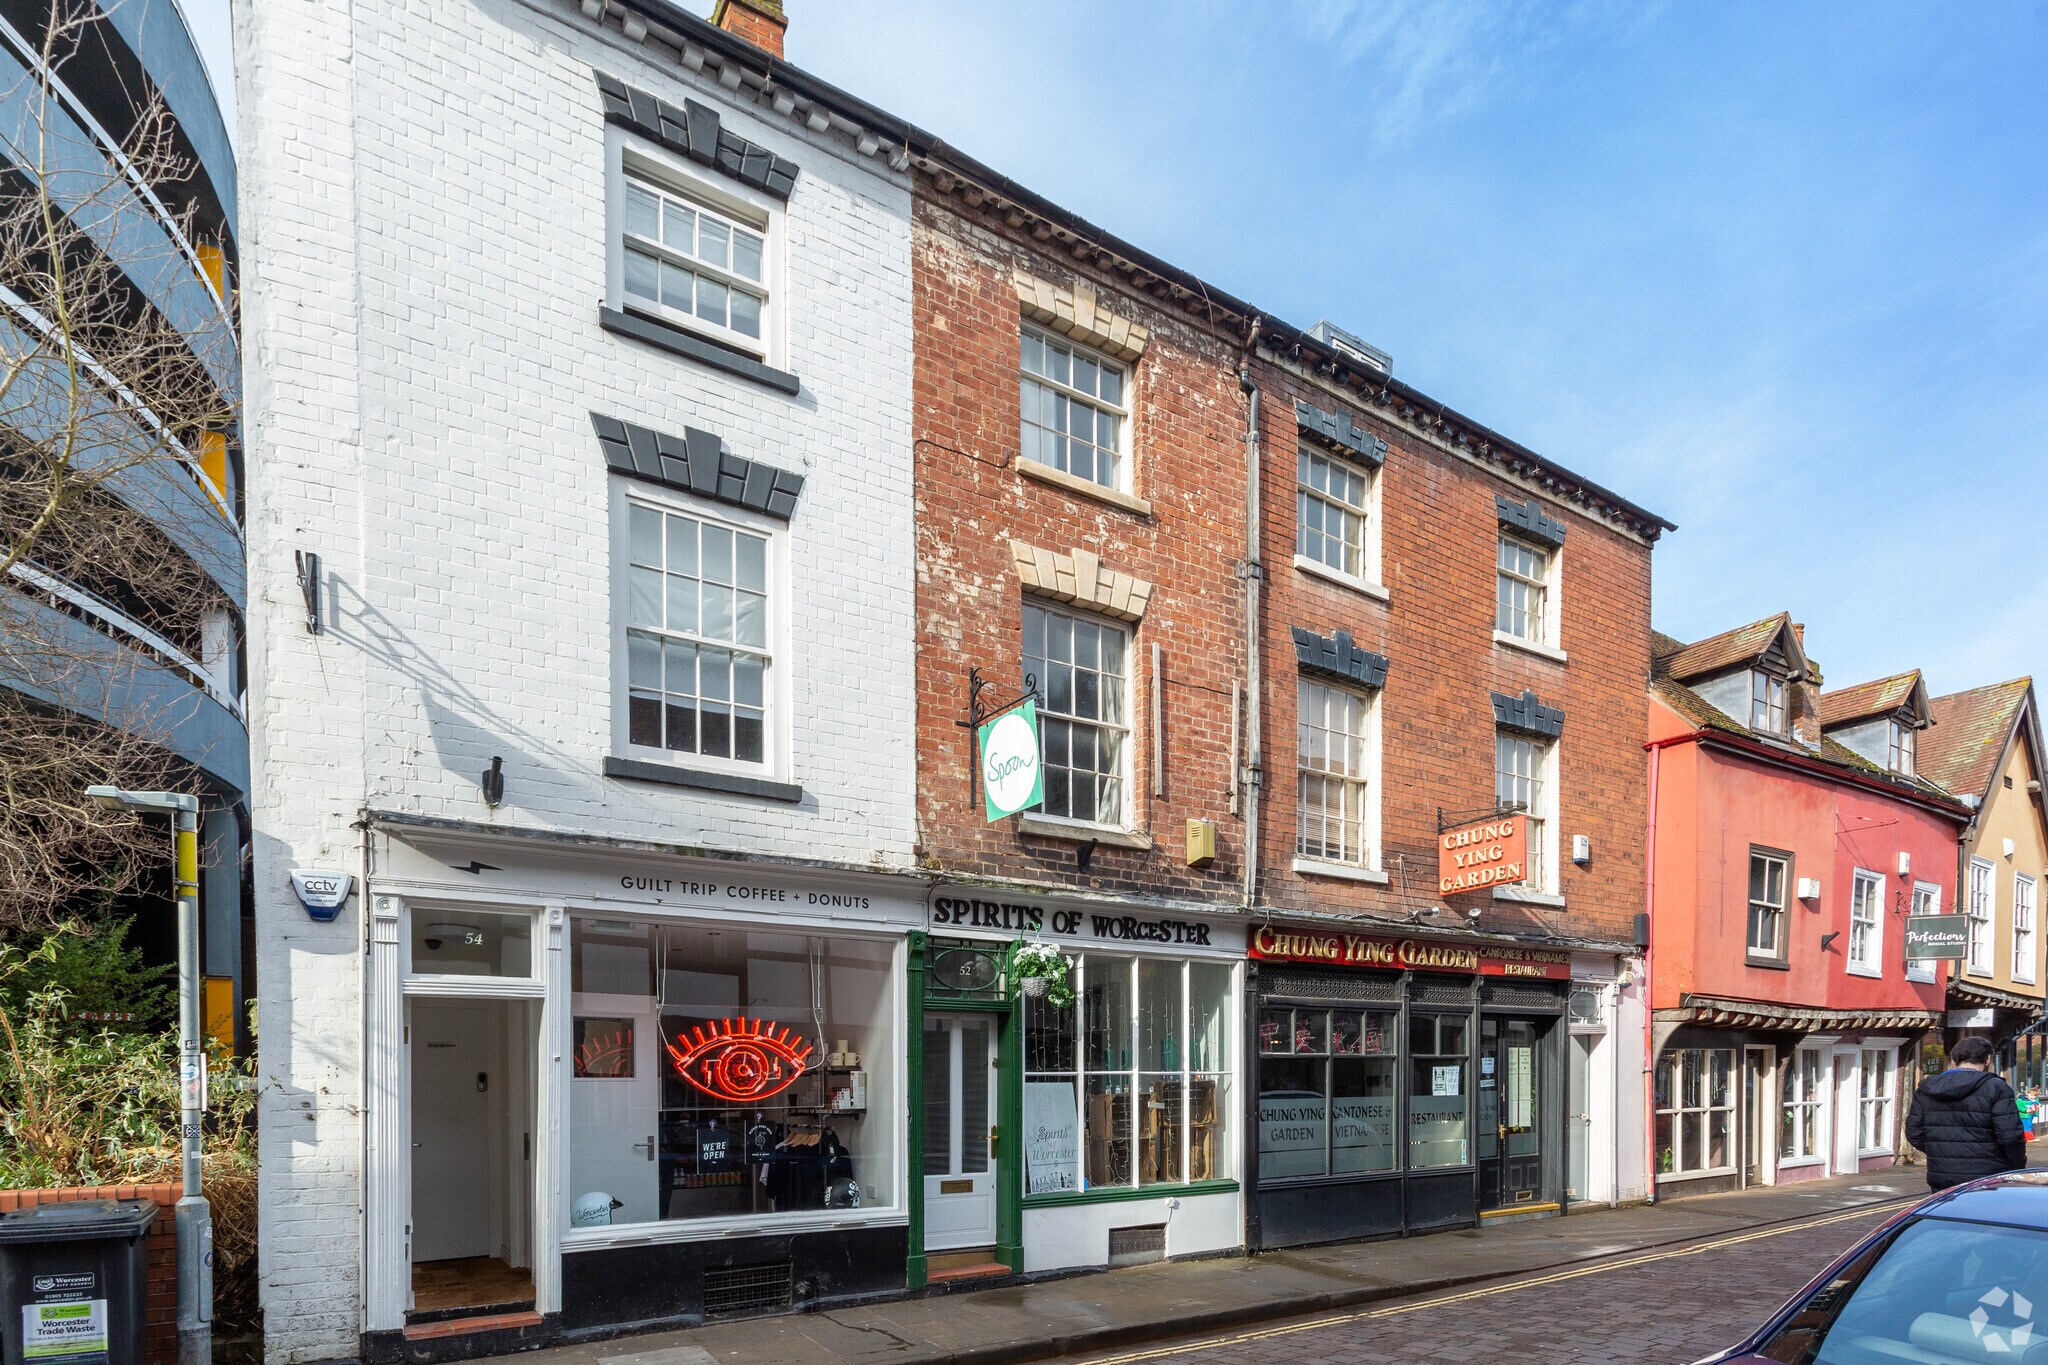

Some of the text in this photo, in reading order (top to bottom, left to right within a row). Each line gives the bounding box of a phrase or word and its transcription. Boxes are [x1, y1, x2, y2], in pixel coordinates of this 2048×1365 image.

[987, 751, 1035, 792] Spoon
[1443, 820, 1514, 850] CHUNG
[1453, 844, 1504, 869] YING
[1439, 861, 1523, 893] GARDEN
[304, 879, 338, 891] cctv
[620, 875, 673, 893] GUILT
[680, 881, 718, 896] TRIP
[726, 885, 786, 902] COFFEE
[808, 892, 870, 909] DONUTS
[933, 897, 1212, 946] SPIRITS OF WORCESTER
[464, 932, 484, 946] 54
[1905, 931, 1967, 944] Perfections
[1253, 927, 1479, 971] CHUNG YING GARDEN
[1479, 946, 1523, 960] CANTONESE
[1525, 950, 1532, 961] &
[959, 965, 971, 976] 52
[1504, 963, 1548, 977] RESTAURANT
[1260, 1107, 1325, 1122] CHUNG YING
[1332, 1105, 1383, 1119] CANTONESE
[1411, 1111, 1463, 1125] RESTAURANT
[1038, 1126, 1068, 1143] Spirits
[1271, 1127, 1315, 1141] GARDEN
[1335, 1123, 1390, 1138] VIETNAESE
[702, 1141, 727, 1151] WE'RE
[703, 1150, 725, 1160] OPEN
[1031, 1148, 1077, 1161] Worcester
[42, 1319, 91, 1327] Worcester
[37, 1325, 96, 1336] Trade Waste
